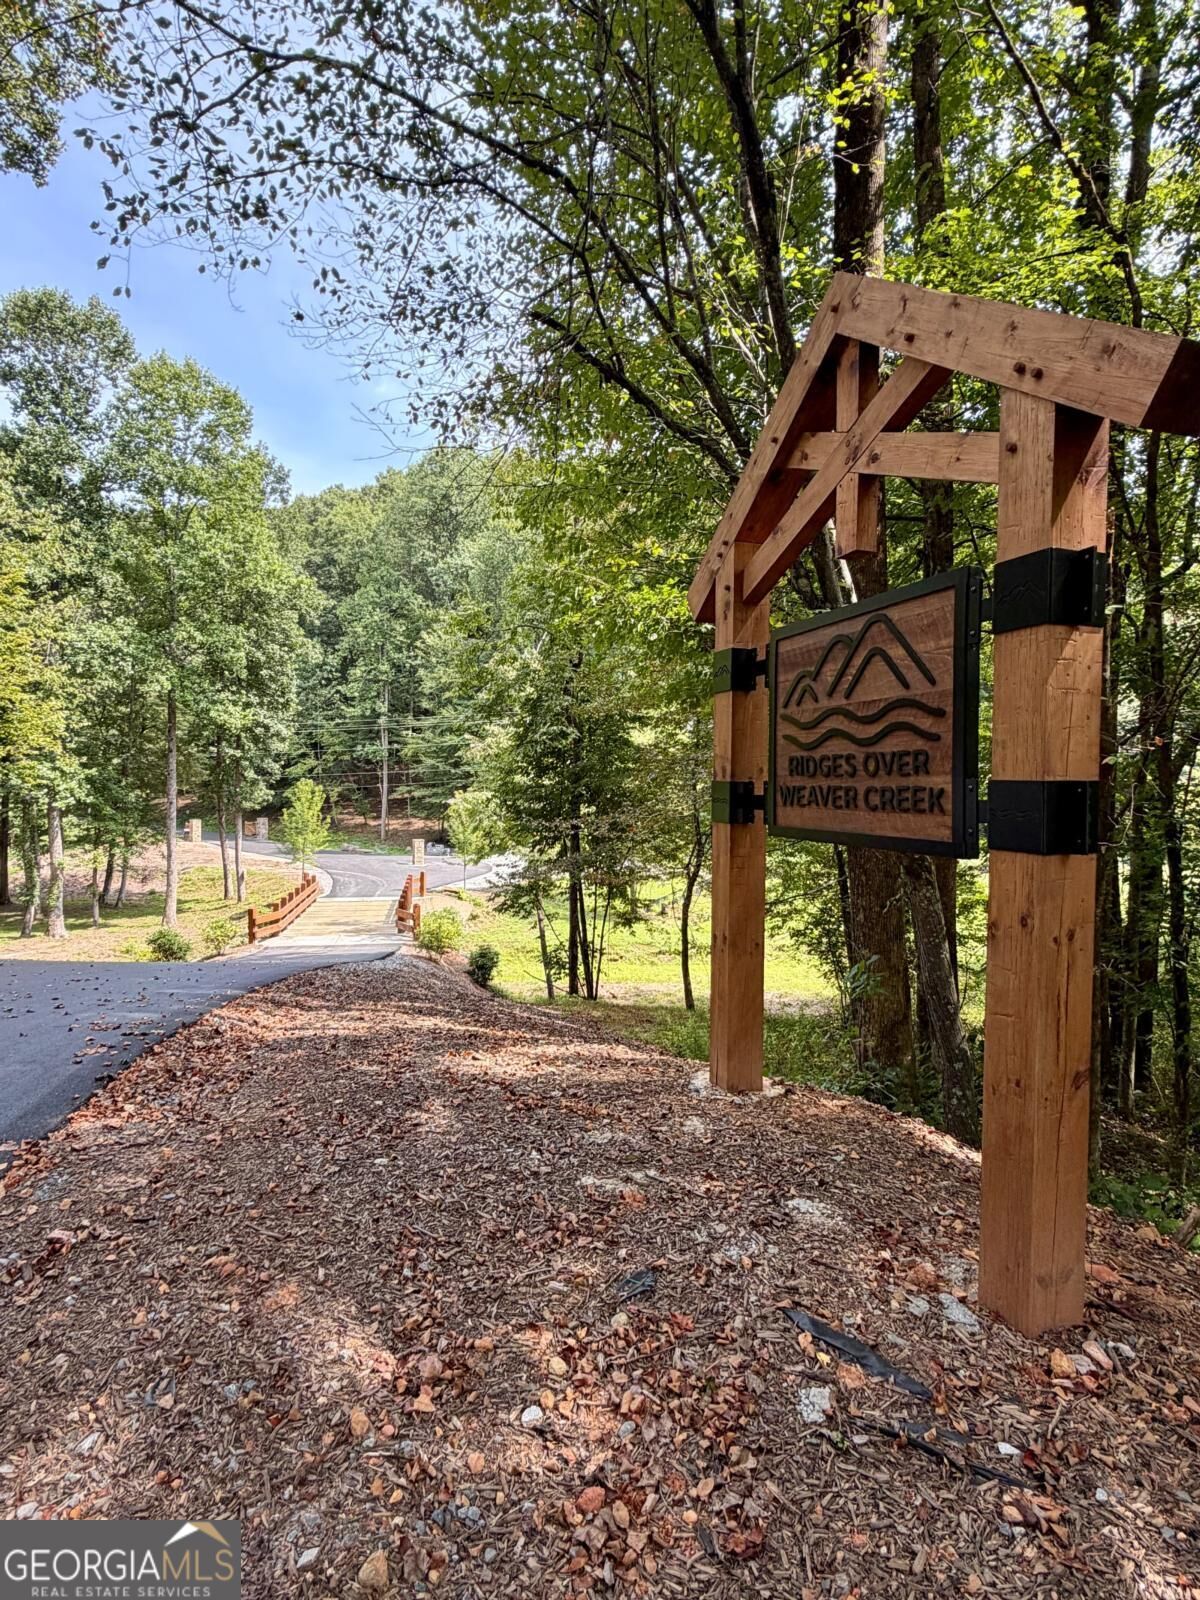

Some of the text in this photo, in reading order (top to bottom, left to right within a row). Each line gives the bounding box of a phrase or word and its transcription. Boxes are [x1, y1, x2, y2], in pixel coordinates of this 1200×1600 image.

[788, 749, 930, 778] RIDGES OVER
[780, 784, 946, 815] WEAVER CREEK
